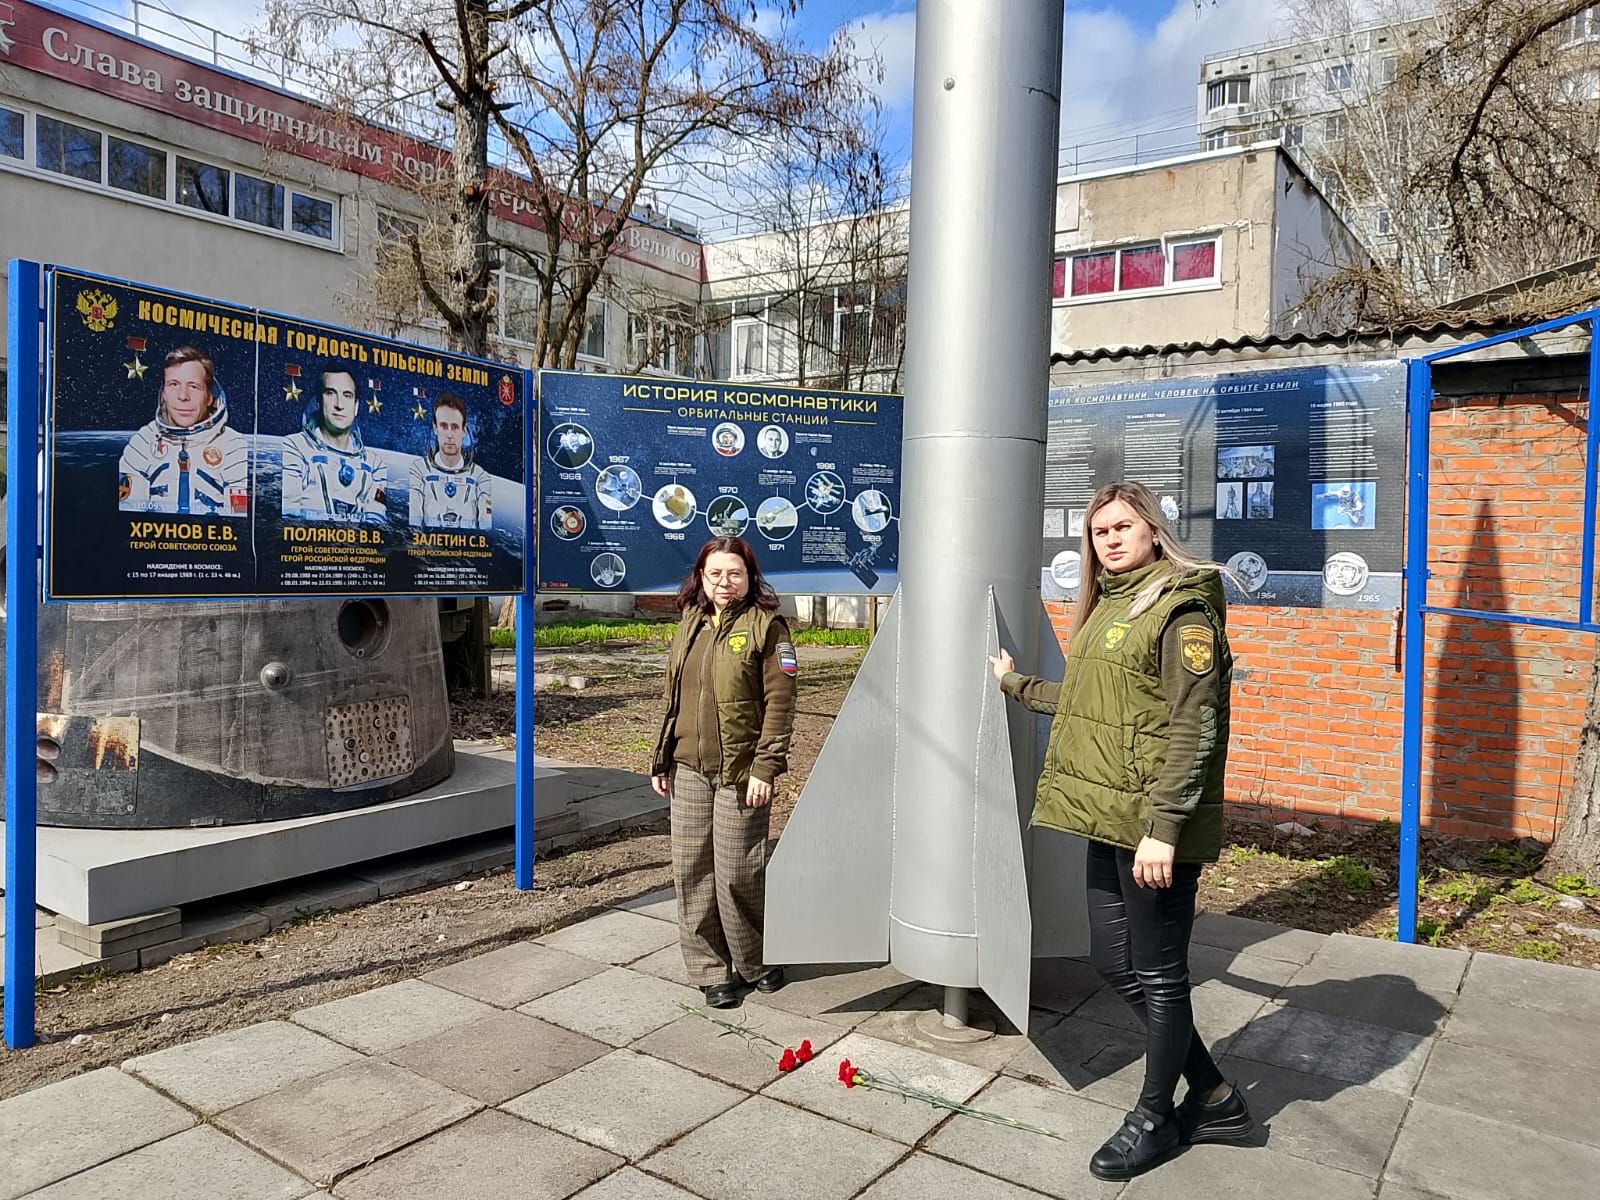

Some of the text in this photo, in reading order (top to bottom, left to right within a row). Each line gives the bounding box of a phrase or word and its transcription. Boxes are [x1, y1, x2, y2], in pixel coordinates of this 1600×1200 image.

[42, 27, 163, 94] Слава
[175, 77, 382, 166] защитникам
[629, 227, 702, 270] Великой
[138, 300, 488, 387] КОСМИЧЕСКАЯ ГОРДОСТЬ ТУЛЬСКОЙ ЗЕМЛИ
[623, 384, 878, 413] ИСТОРИЯ КОСМОНАВТИКИ
[1074, 392, 1148, 404] КОСМОНАВТИКИ
[1154, 388, 1199, 398] ЧЕЛОВЕК
[1203, 387, 1216, 395] НА
[1220, 384, 1259, 394] ОРБИТЕ
[1263, 381, 1299, 391] ЗЕМЛИ
[677, 407, 828, 426] ОРБИТАЛЬНЫЕ СТАНЦИИ
[718, 486, 739, 494] 1970
[130, 522, 238, 541] ХРУНОВ Е.В.
[283, 527, 385, 544] ПОЛЯКОВ В.В.
[130, 541, 237, 552] ГЕРОЙ СОВЕТСКОГО СОЮЗА
[412, 532, 489, 548] ЗАЛЕТИН С.В.
[769, 543, 785, 551] 1971
[291, 545, 378, 555] ГЕРОЙ СОВЕТСКОГО СОЮЗА
[280, 554, 386, 564] ГЕРОЙ РОССИЙСКОЙ ФЕДЕРАЦИИ
[1256, 592, 1276, 600] 1964
[1358, 594, 1380, 602] 1965
